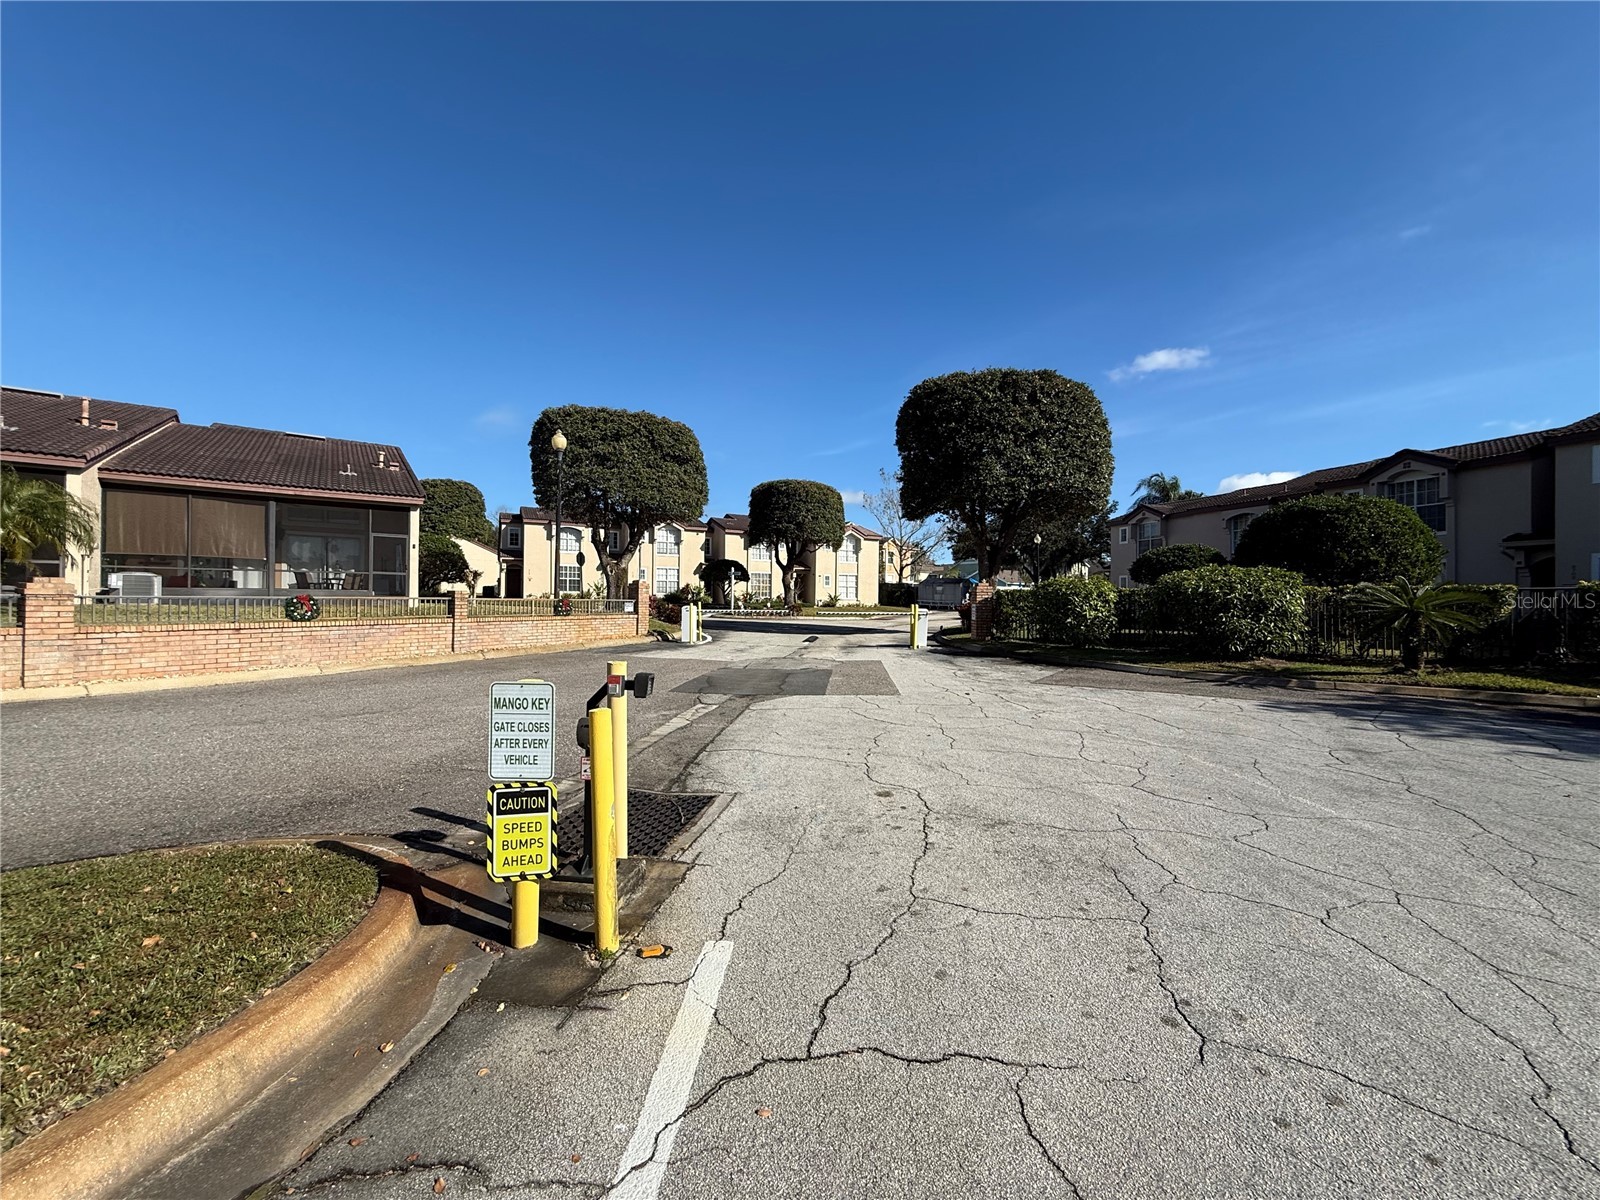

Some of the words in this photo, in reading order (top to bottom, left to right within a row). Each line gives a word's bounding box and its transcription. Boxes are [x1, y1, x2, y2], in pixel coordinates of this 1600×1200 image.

[493, 697, 529, 710] MANGO
[531, 697, 551, 710] KEY
[493, 722, 516, 733] GATE
[517, 721, 550, 733] CLOSES
[493, 738, 521, 749] AFTER
[522, 738, 549, 749] EVERY
[503, 754, 539, 765] VEHICLE
[499, 796, 546, 811] CAUTION
[503, 821, 543, 834] SPEED
[501, 837, 544, 851] BUMPS
[502, 853, 543, 868] AHEAD
